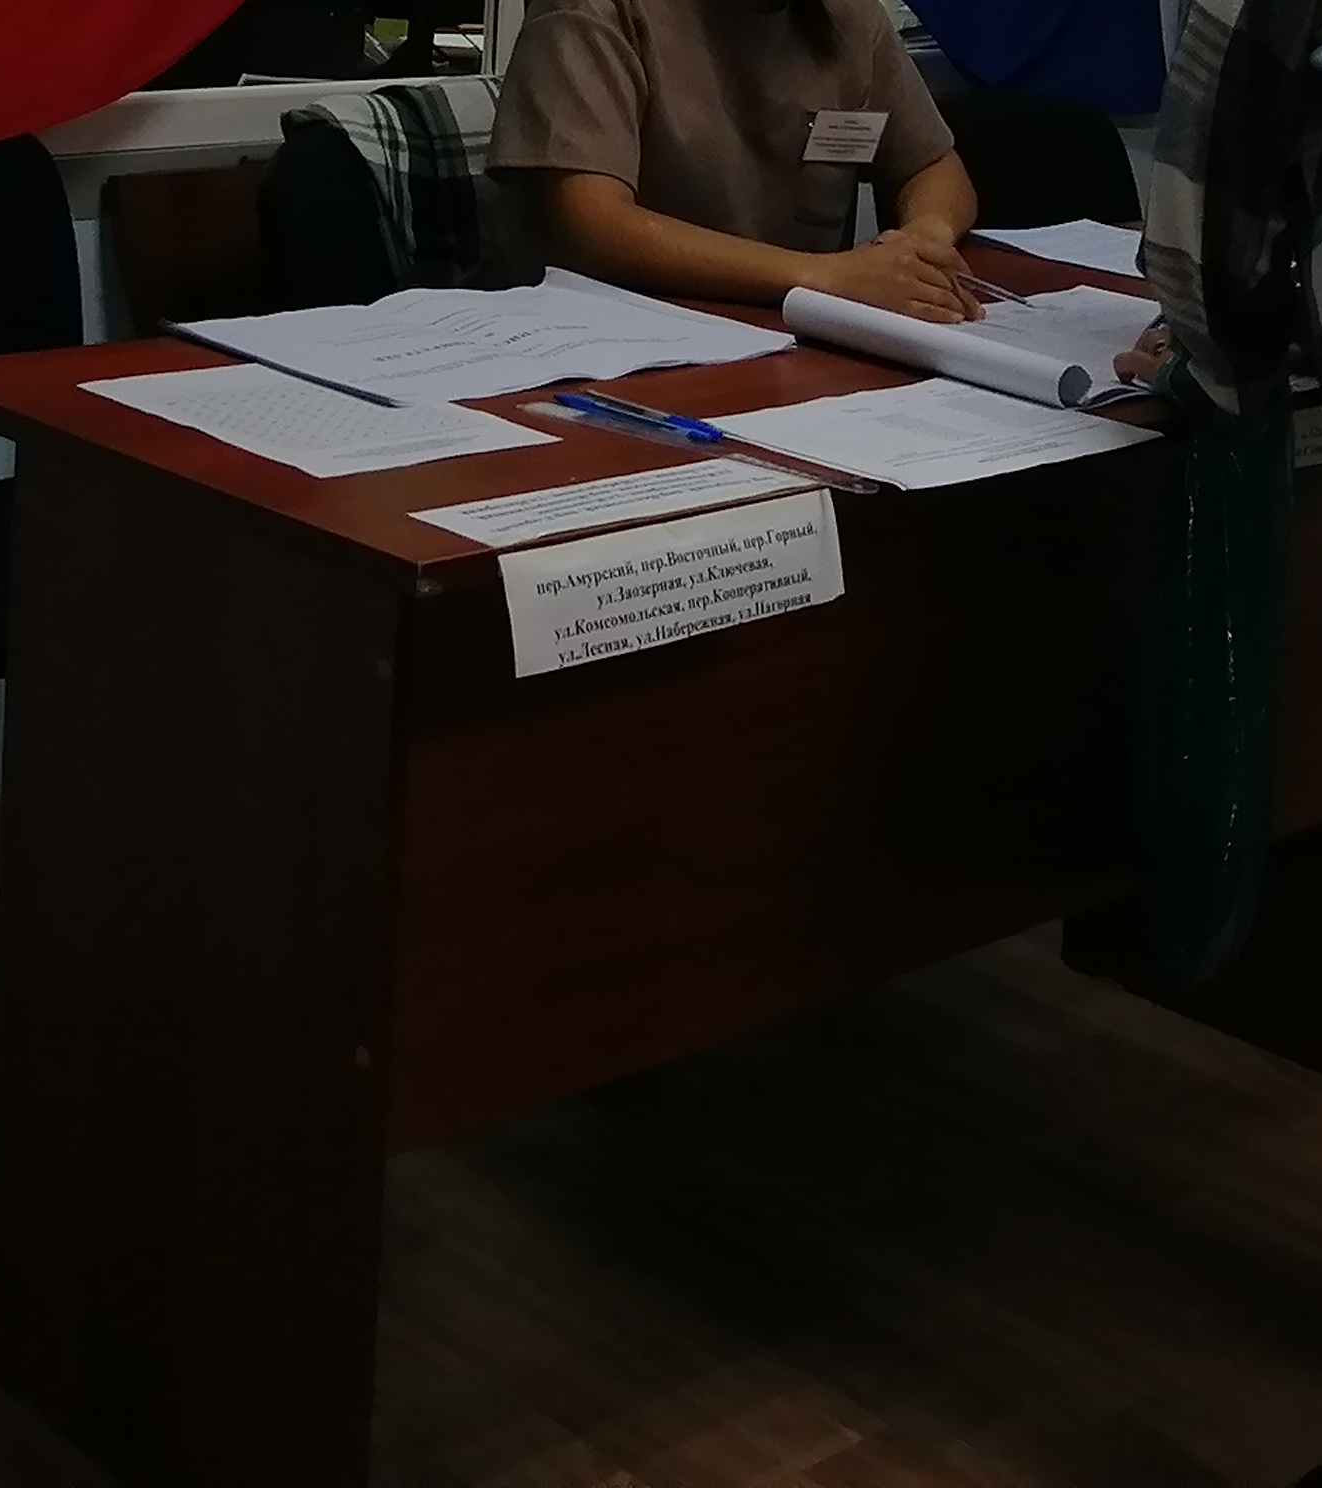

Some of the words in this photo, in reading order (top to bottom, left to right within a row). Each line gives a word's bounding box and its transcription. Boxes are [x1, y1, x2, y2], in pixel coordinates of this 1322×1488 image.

[536, 560, 639, 596] пер.Амурский,
[688, 557, 774, 590] ул.Ключевая,
[554, 599, 685, 646] ул.Комсомольская,
